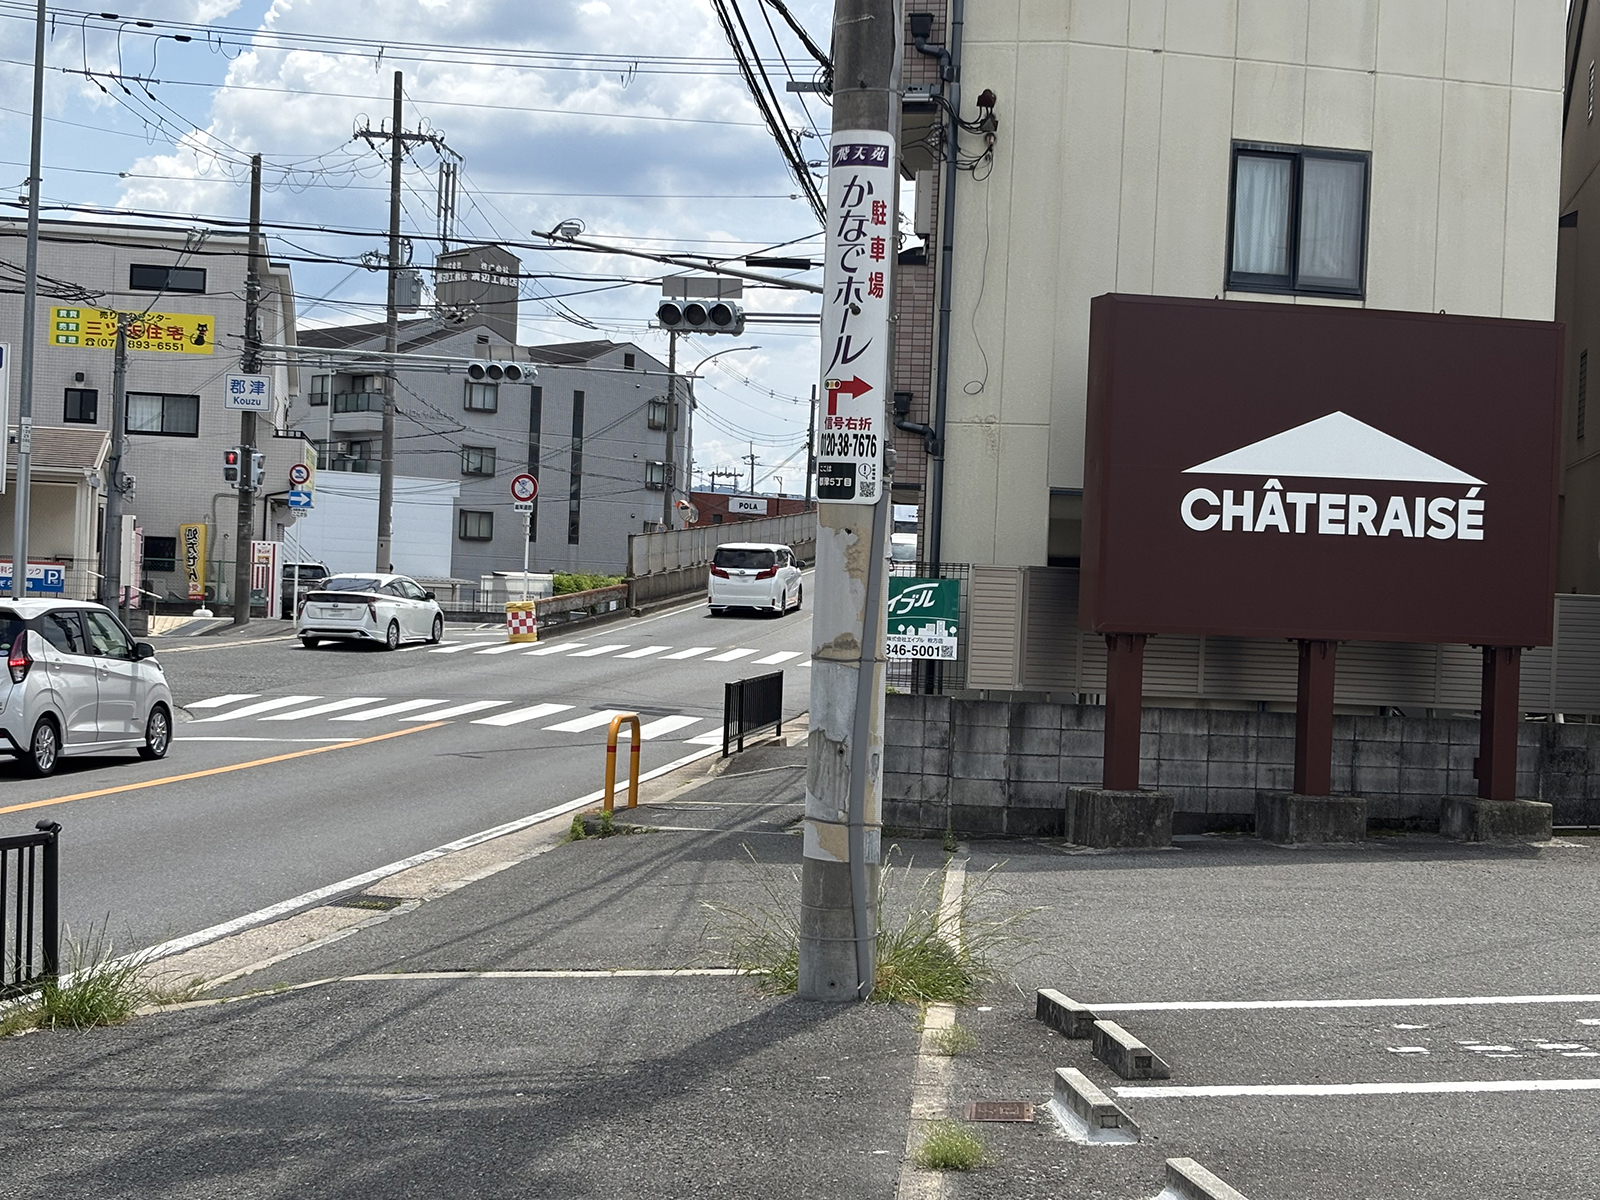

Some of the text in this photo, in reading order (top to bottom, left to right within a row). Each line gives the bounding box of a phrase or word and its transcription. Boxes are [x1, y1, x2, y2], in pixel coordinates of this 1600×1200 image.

[867, 200, 887, 299] 駐車場
[823, 174, 874, 377] かなでホール
[97, 338, 184, 351] (07893-6551
[230, 379, 265, 395] 郡津
[233, 396, 261, 405] Kouzu
[824, 416, 872, 431] 信号右折
[738, 502, 758, 510] POLA
[1180, 478, 1485, 541] CHÂTERAISÉ
[0, 565, 42, 575] 科クック
[47, 570, 59, 584] P
